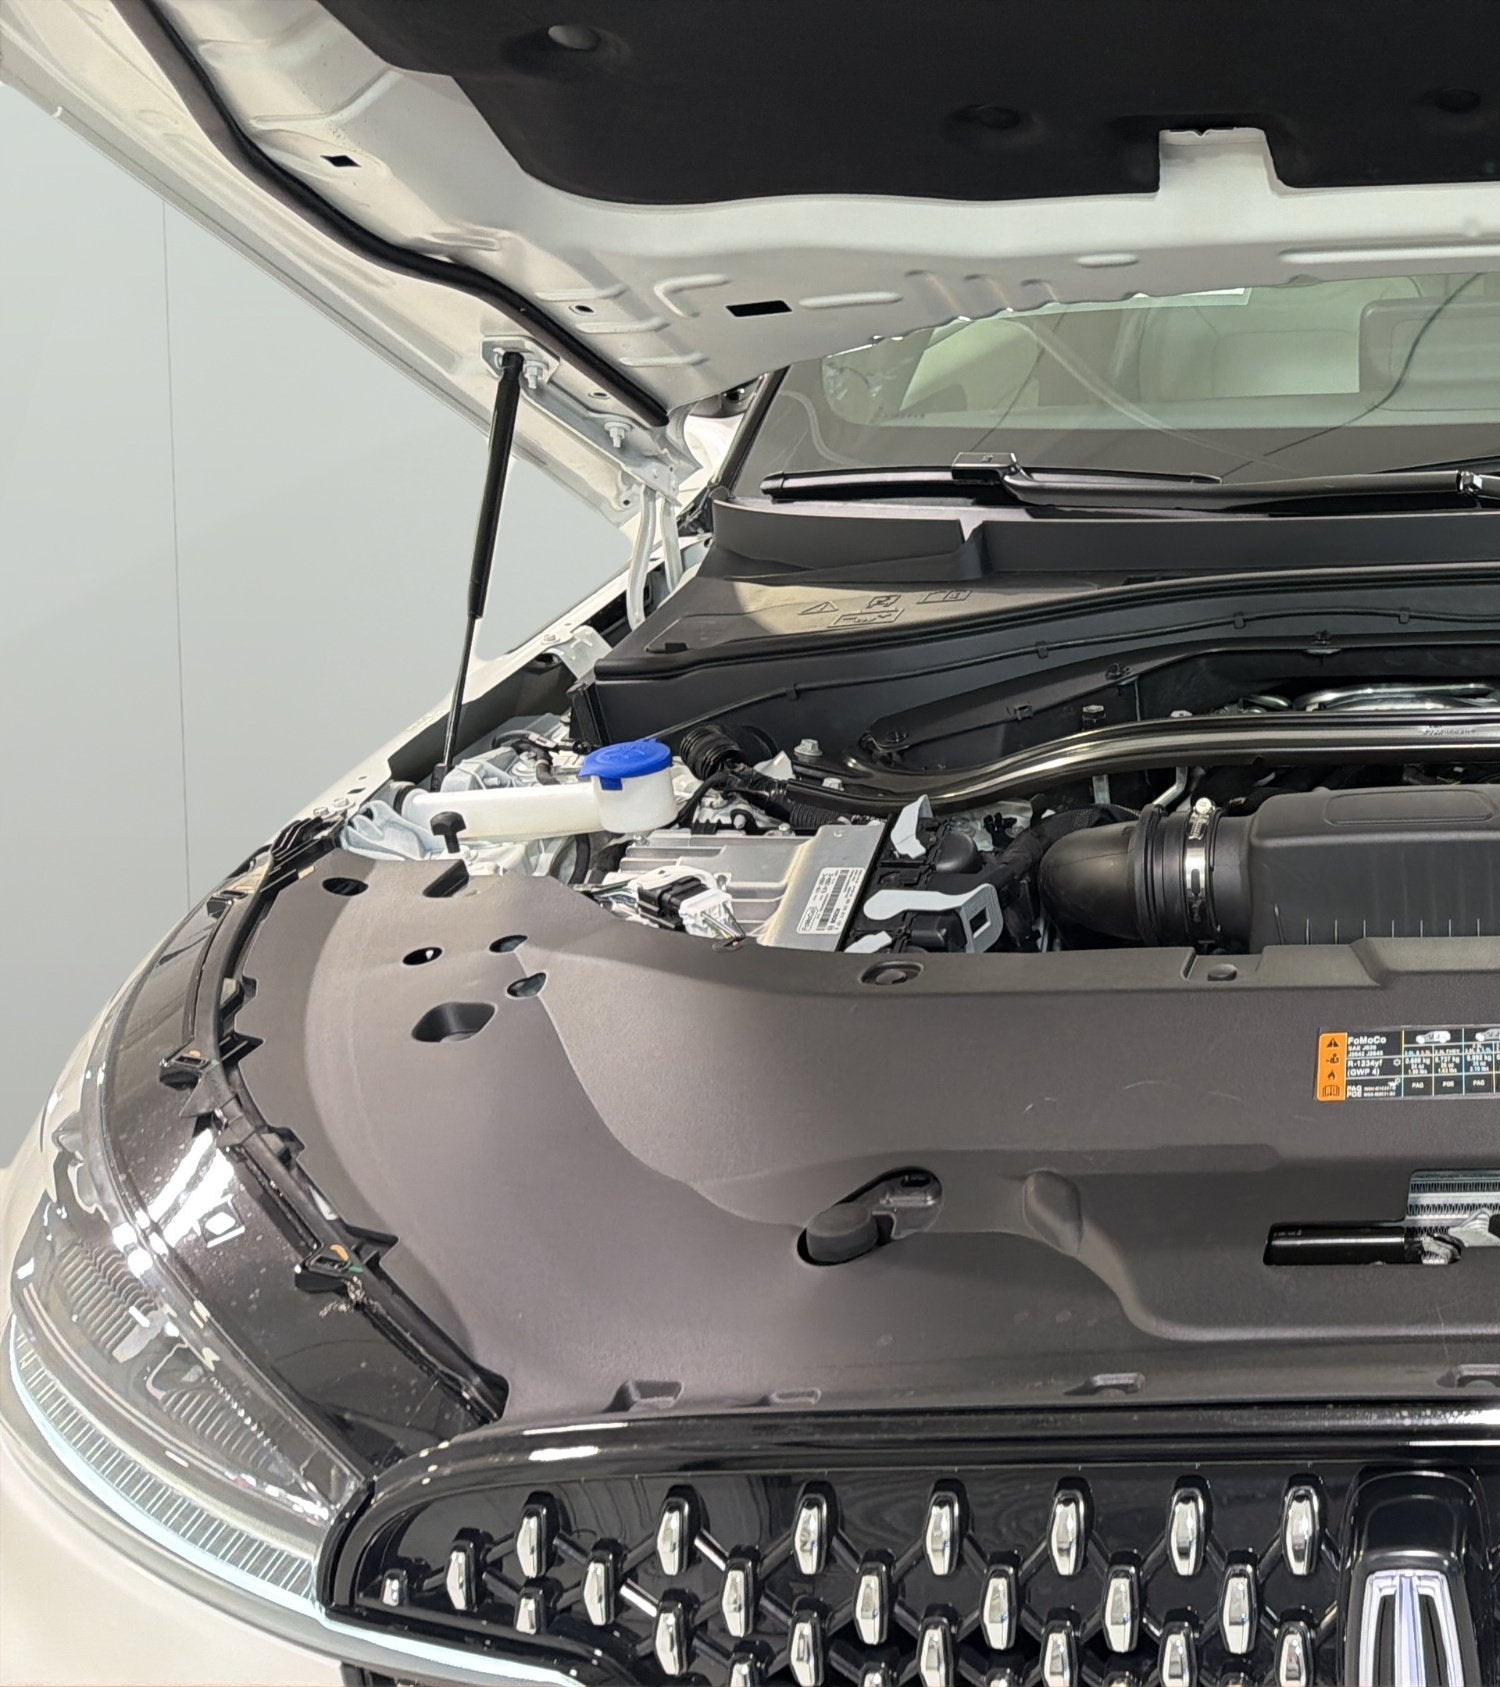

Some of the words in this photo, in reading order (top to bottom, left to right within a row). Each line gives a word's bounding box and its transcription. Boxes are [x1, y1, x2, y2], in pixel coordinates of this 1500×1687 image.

[1347, 1035, 1387, 1045] FoMoCo
[1348, 1059, 1383, 1068] R-1234yf
[1347, 1068, 1370, 1077] (GWP
[1372, 1067, 1380, 1076] 4)
